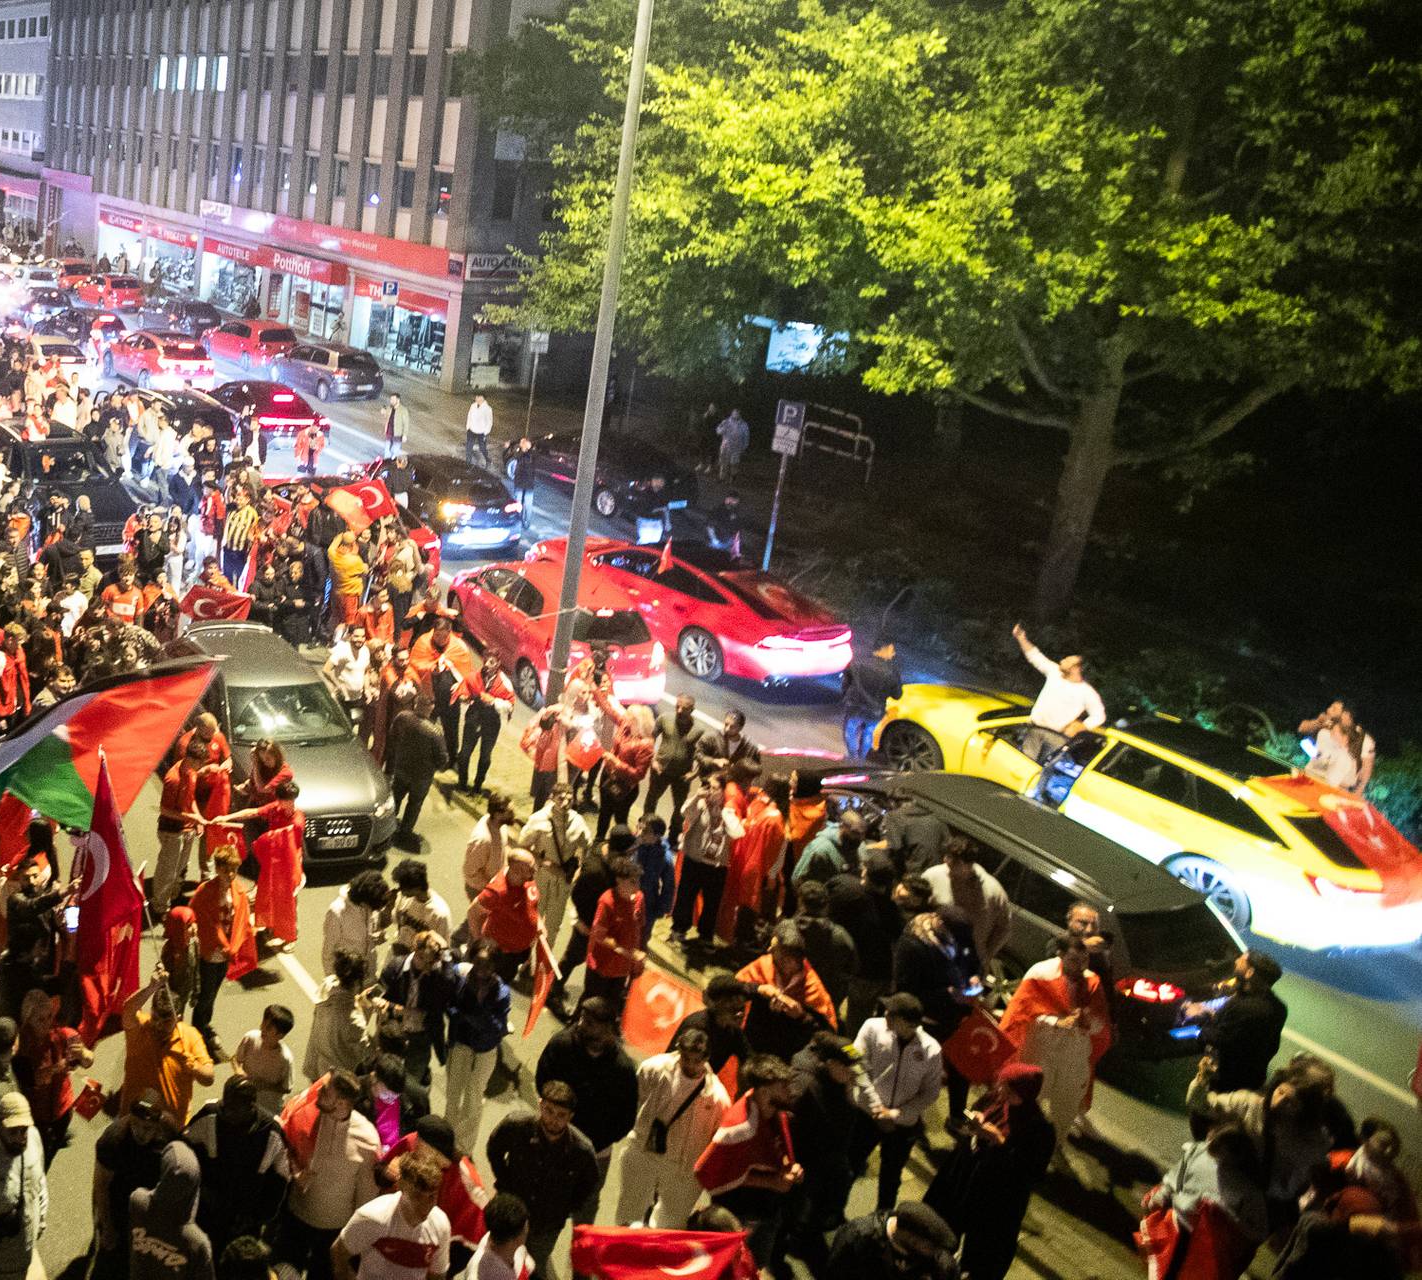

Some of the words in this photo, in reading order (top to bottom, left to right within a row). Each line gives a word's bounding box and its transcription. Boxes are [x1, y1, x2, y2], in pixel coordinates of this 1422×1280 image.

[217, 243, 250, 261] AUTOTEILE
[273, 252, 312, 277] Potthoff
[471, 256, 499, 268] AUTO
[385, 282, 395, 294] P
[782, 404, 798, 423] P
